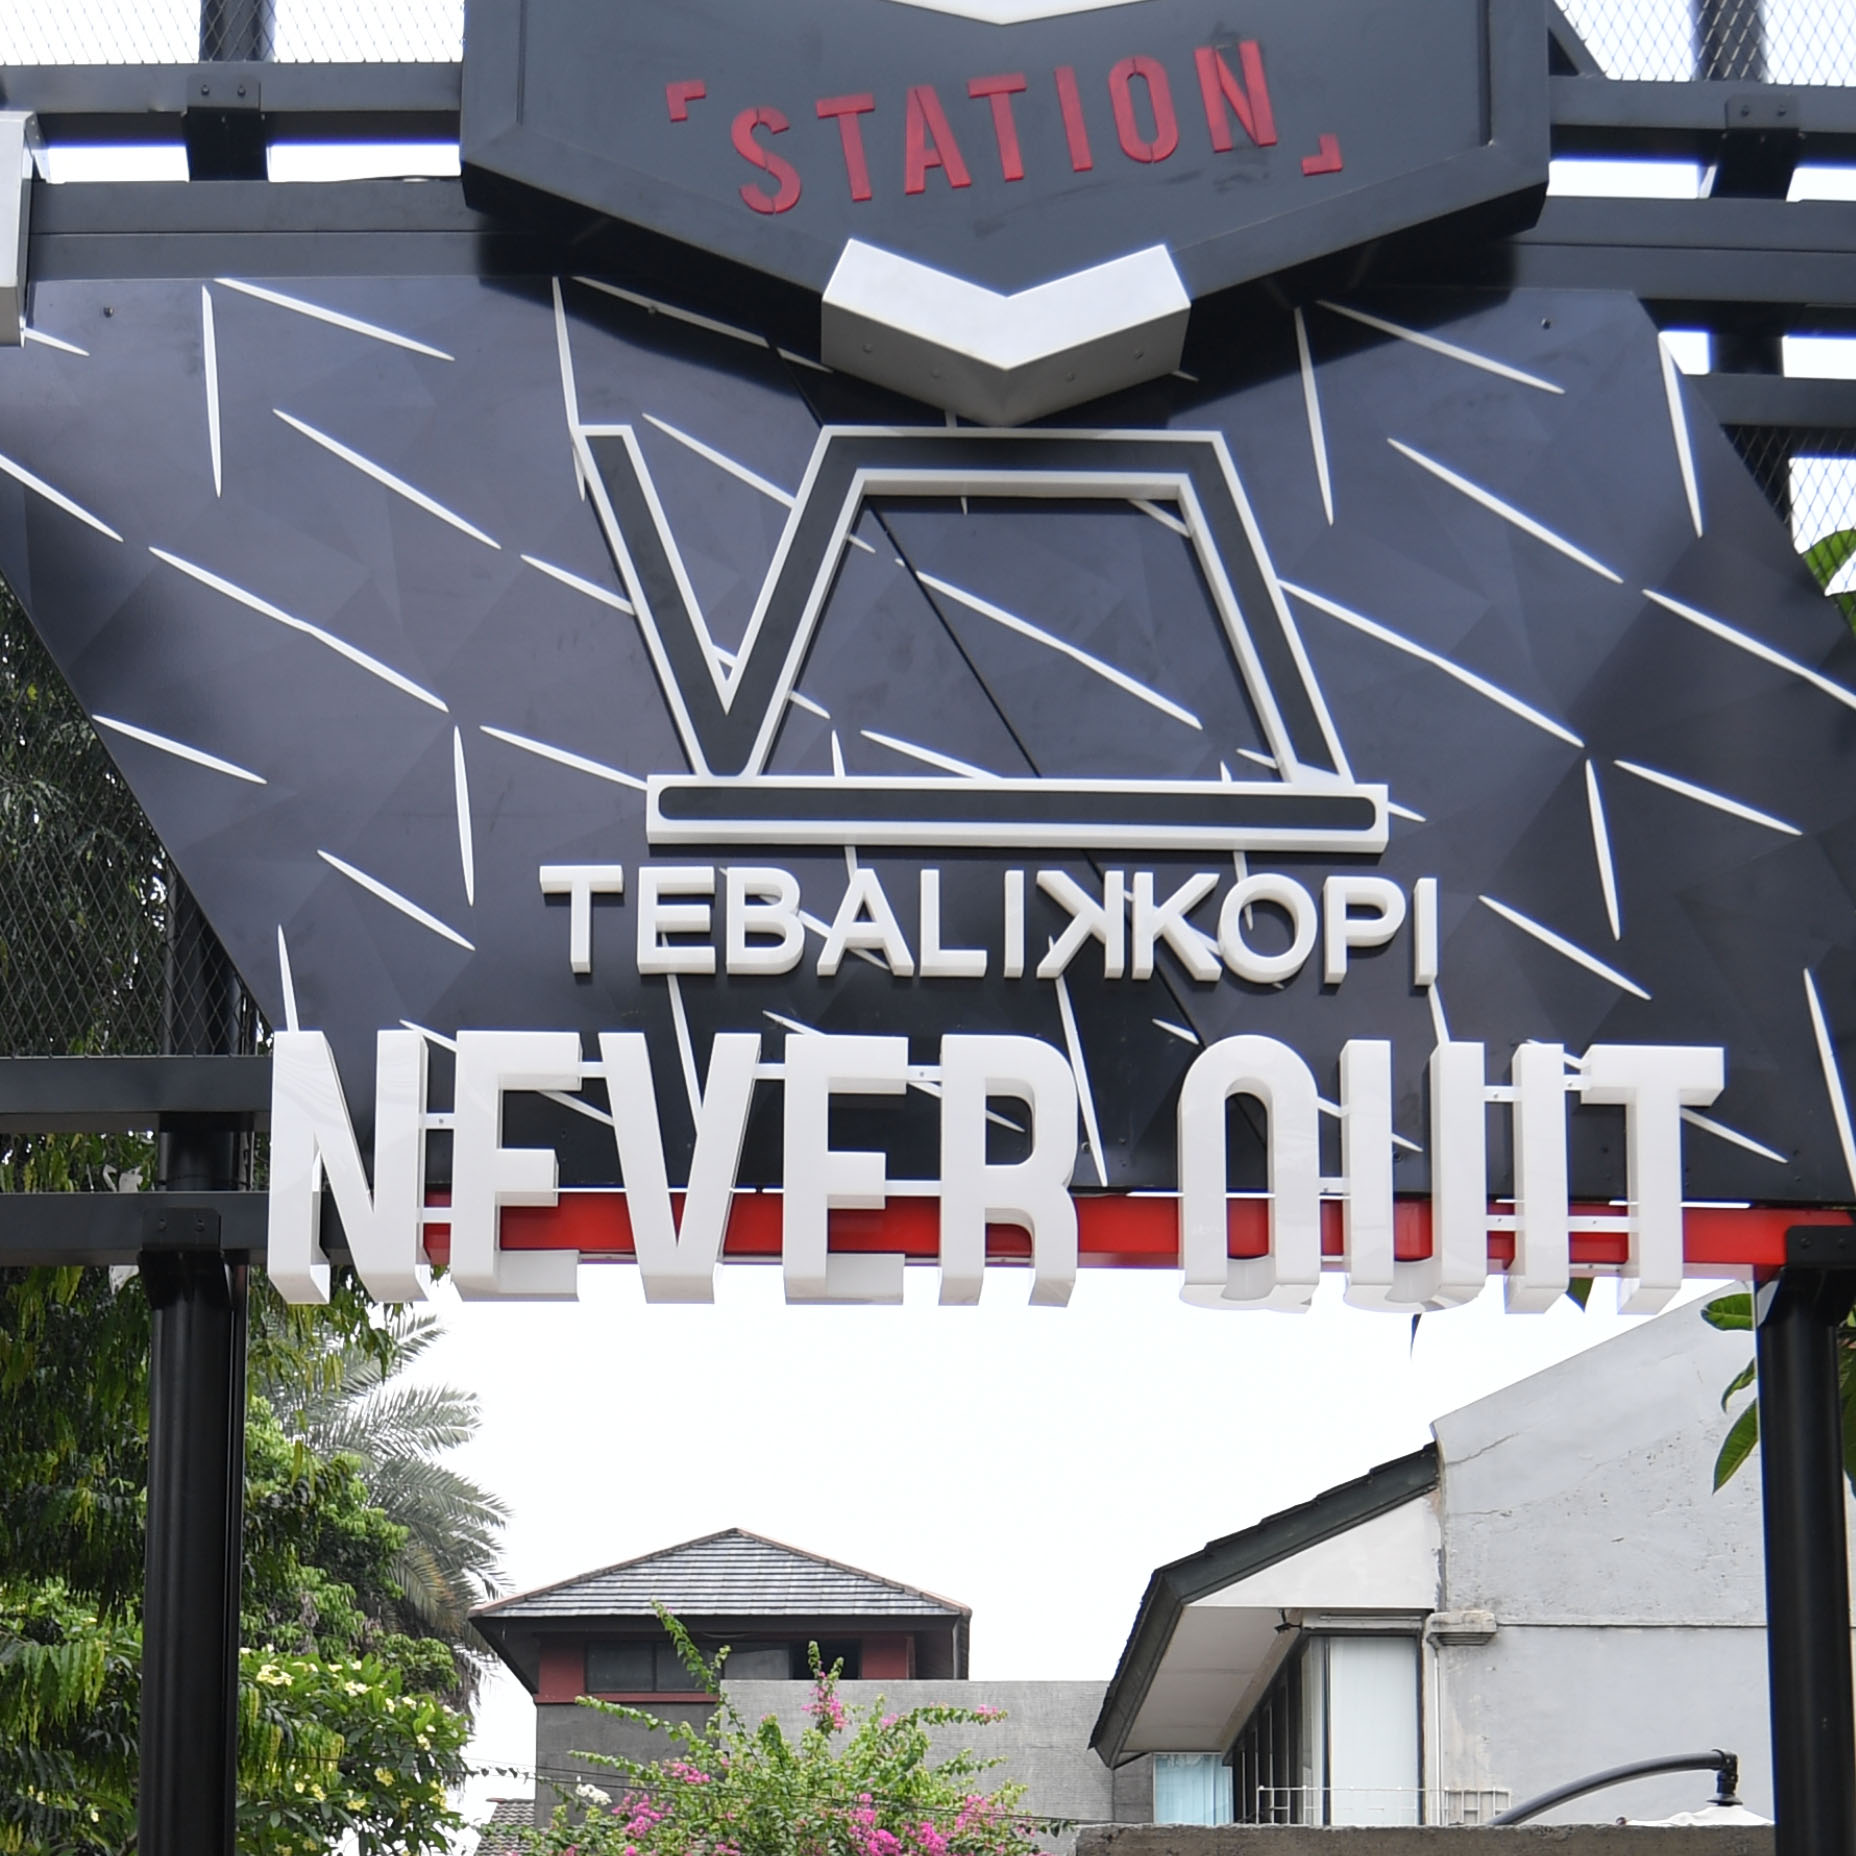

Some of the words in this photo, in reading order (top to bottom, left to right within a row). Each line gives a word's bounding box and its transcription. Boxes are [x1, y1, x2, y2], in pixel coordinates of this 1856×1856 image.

[728, 38, 1279, 216] STATION
[267, 1029, 1079, 1307] NEVER
[1178, 1034, 1725, 1314] QUIT
